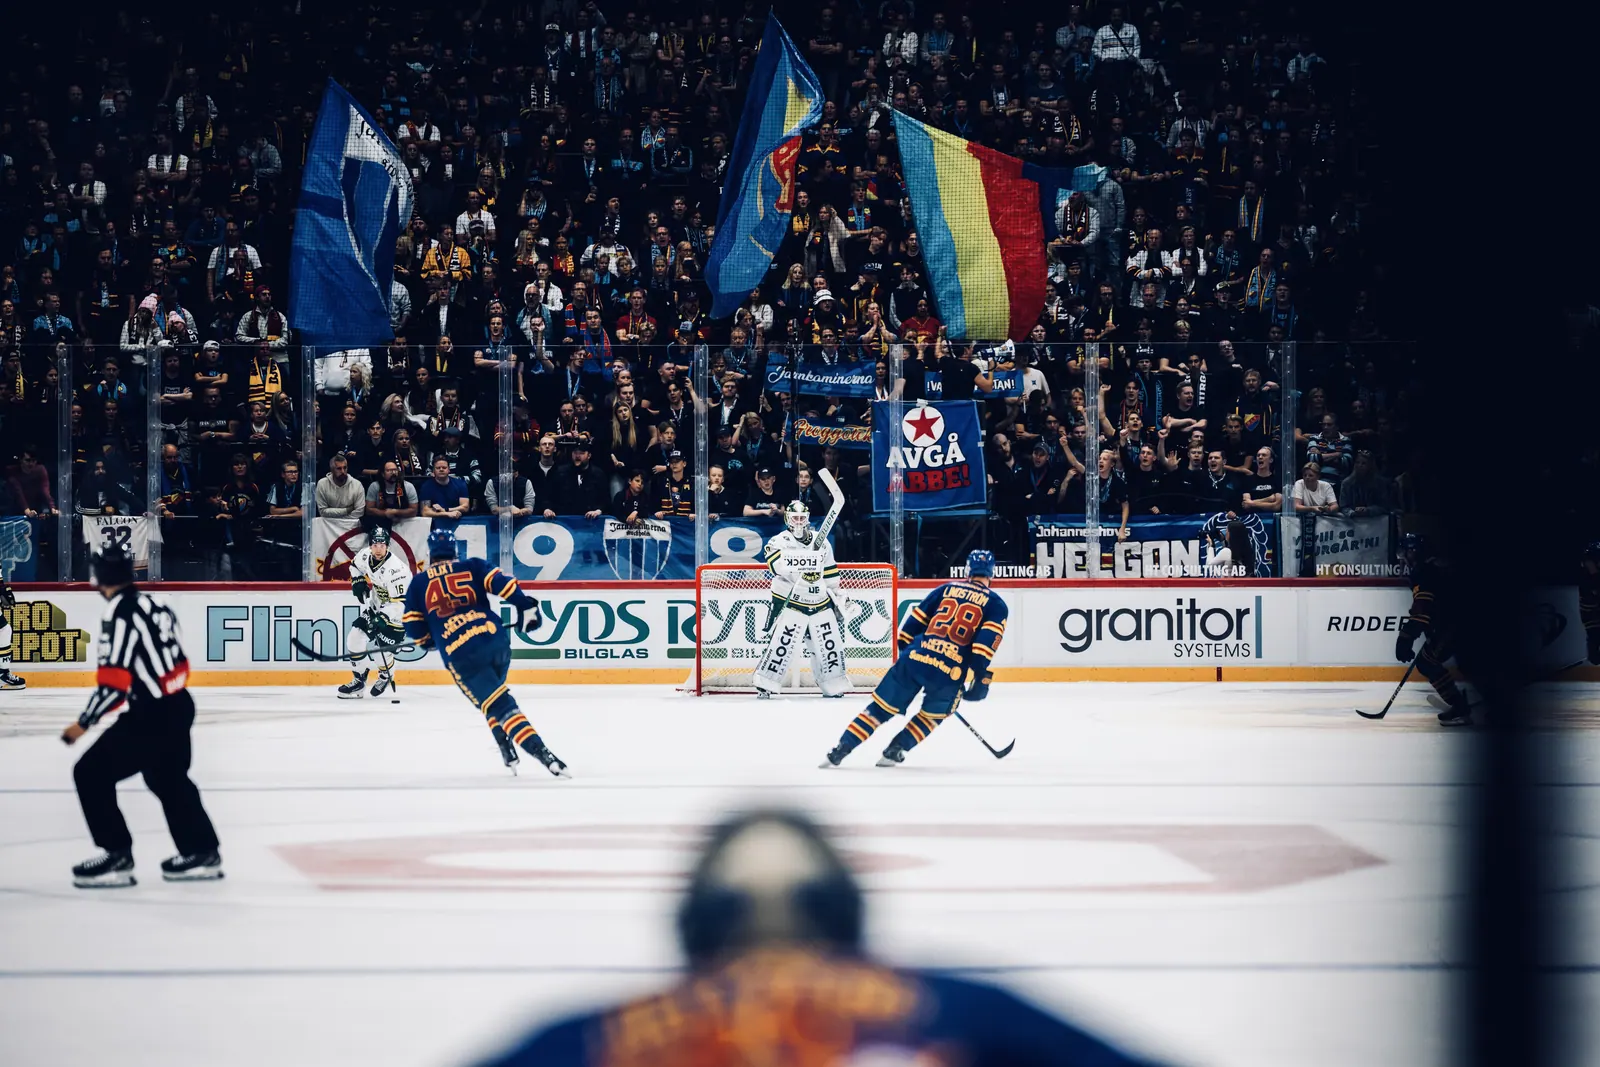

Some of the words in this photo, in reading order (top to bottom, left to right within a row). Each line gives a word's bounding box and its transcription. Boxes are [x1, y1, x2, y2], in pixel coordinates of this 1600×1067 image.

[886, 432, 966, 469] AVGÅ
[887, 464, 970, 493] ABBE!
[96, 516, 138, 526] FALCON
[100, 526, 132, 549] 32
[950, 566, 965, 578] HT
[1036, 566, 1051, 578] AB
[1145, 565, 1159, 578] HT
[1162, 565, 1228, 578] CONSULTING
[1231, 565, 1246, 577] AB
[1316, 564, 1330, 576] HT
[1333, 564, 1401, 576] CONSULTING
[1402, 564, 1412, 576] A
[395, 584, 404, 594] 16
[425, 571, 477, 618] 45
[925, 597, 983, 646] 28
[1059, 599, 1250, 653] granitor
[564, 648, 649, 659] BILGLAS
[767, 623, 797, 673] FLOCK.
[820, 622, 839, 673] FLOCK.
[1174, 643, 1251, 658] SYSTEMS
